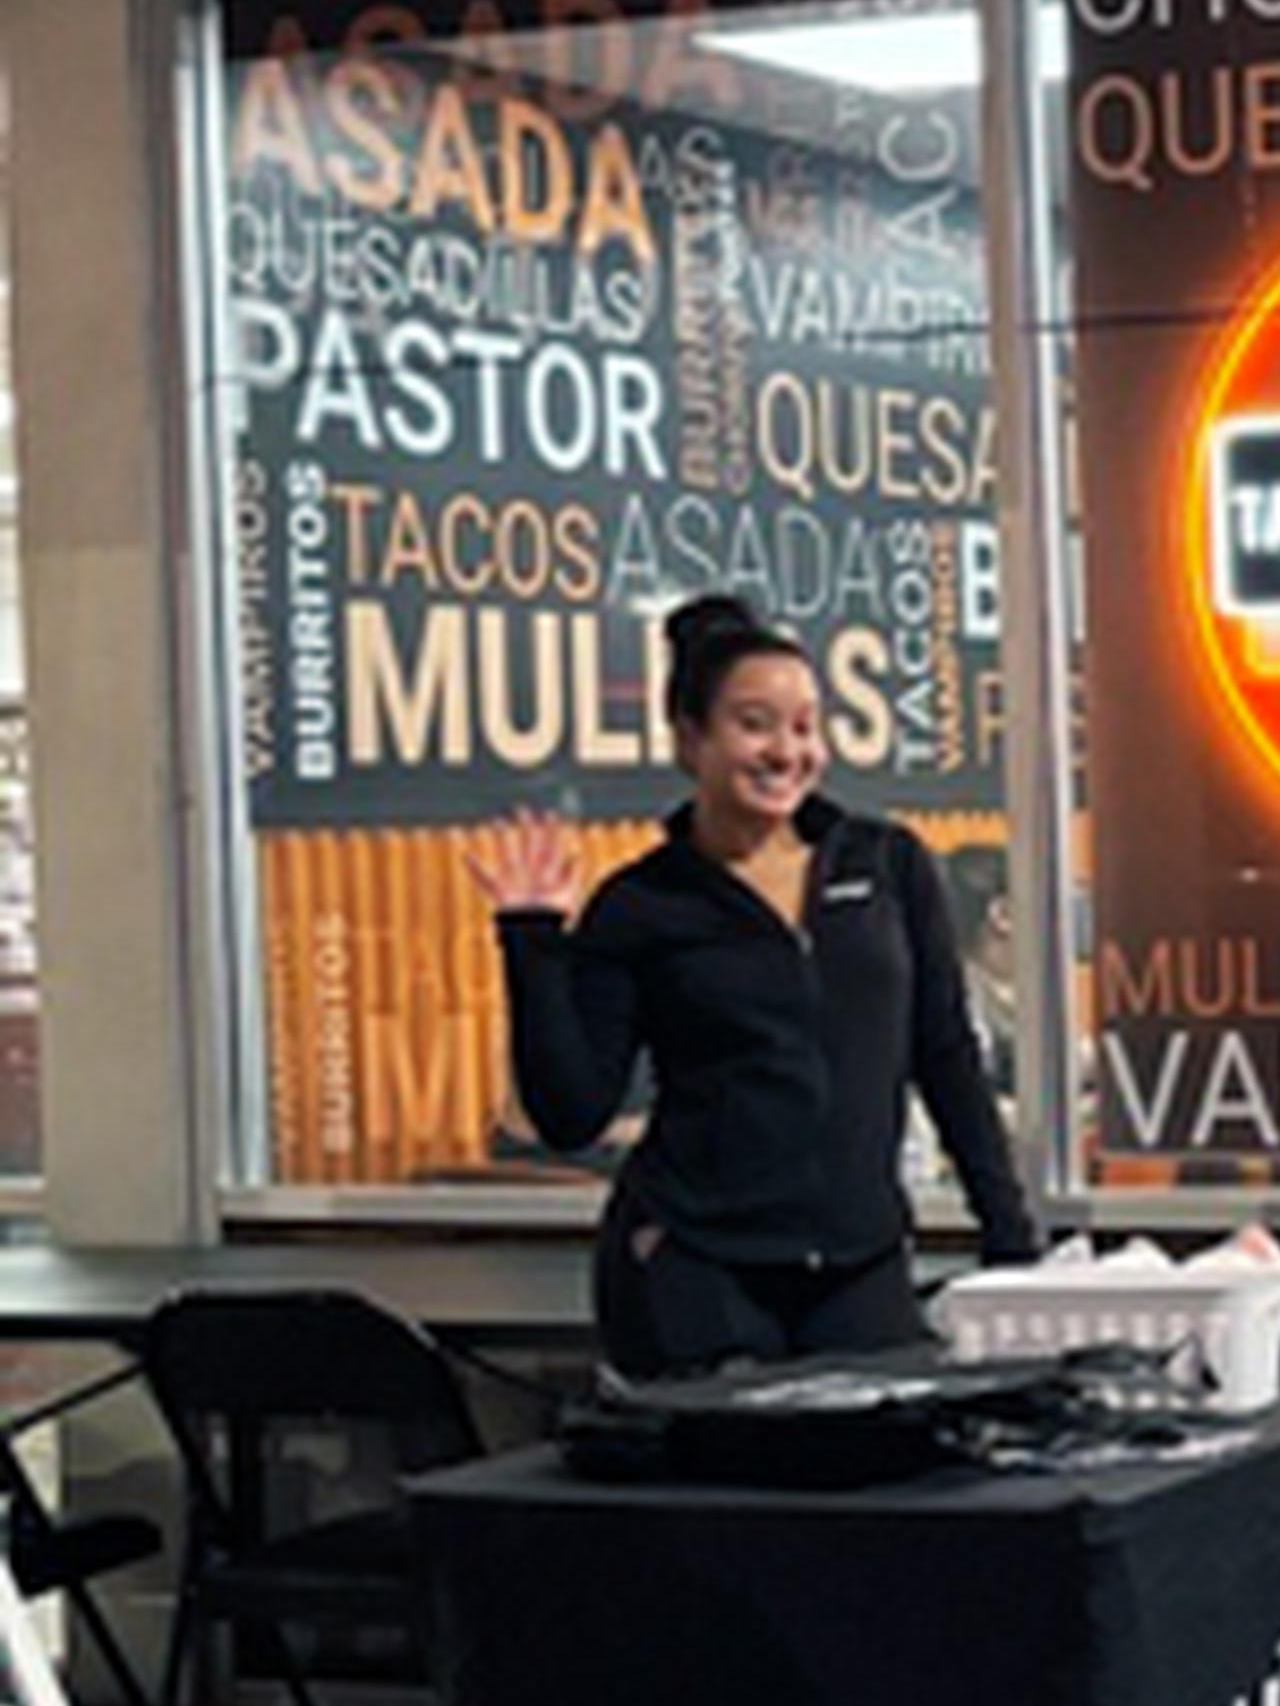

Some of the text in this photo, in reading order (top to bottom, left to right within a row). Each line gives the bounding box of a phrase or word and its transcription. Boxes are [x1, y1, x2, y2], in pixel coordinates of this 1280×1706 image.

[232, 58, 660, 263] ASADA
[226, 205, 650, 348] QUESADILLAS
[218, 299, 668, 481] PASTOR
[286, 458, 337, 781] BURRITOS
[328, 483, 600, 599] TACOS
[603, 495, 888, 619] ASADA
[343, 598, 892, 767] MULIS
[888, 517, 935, 777] TACOS
